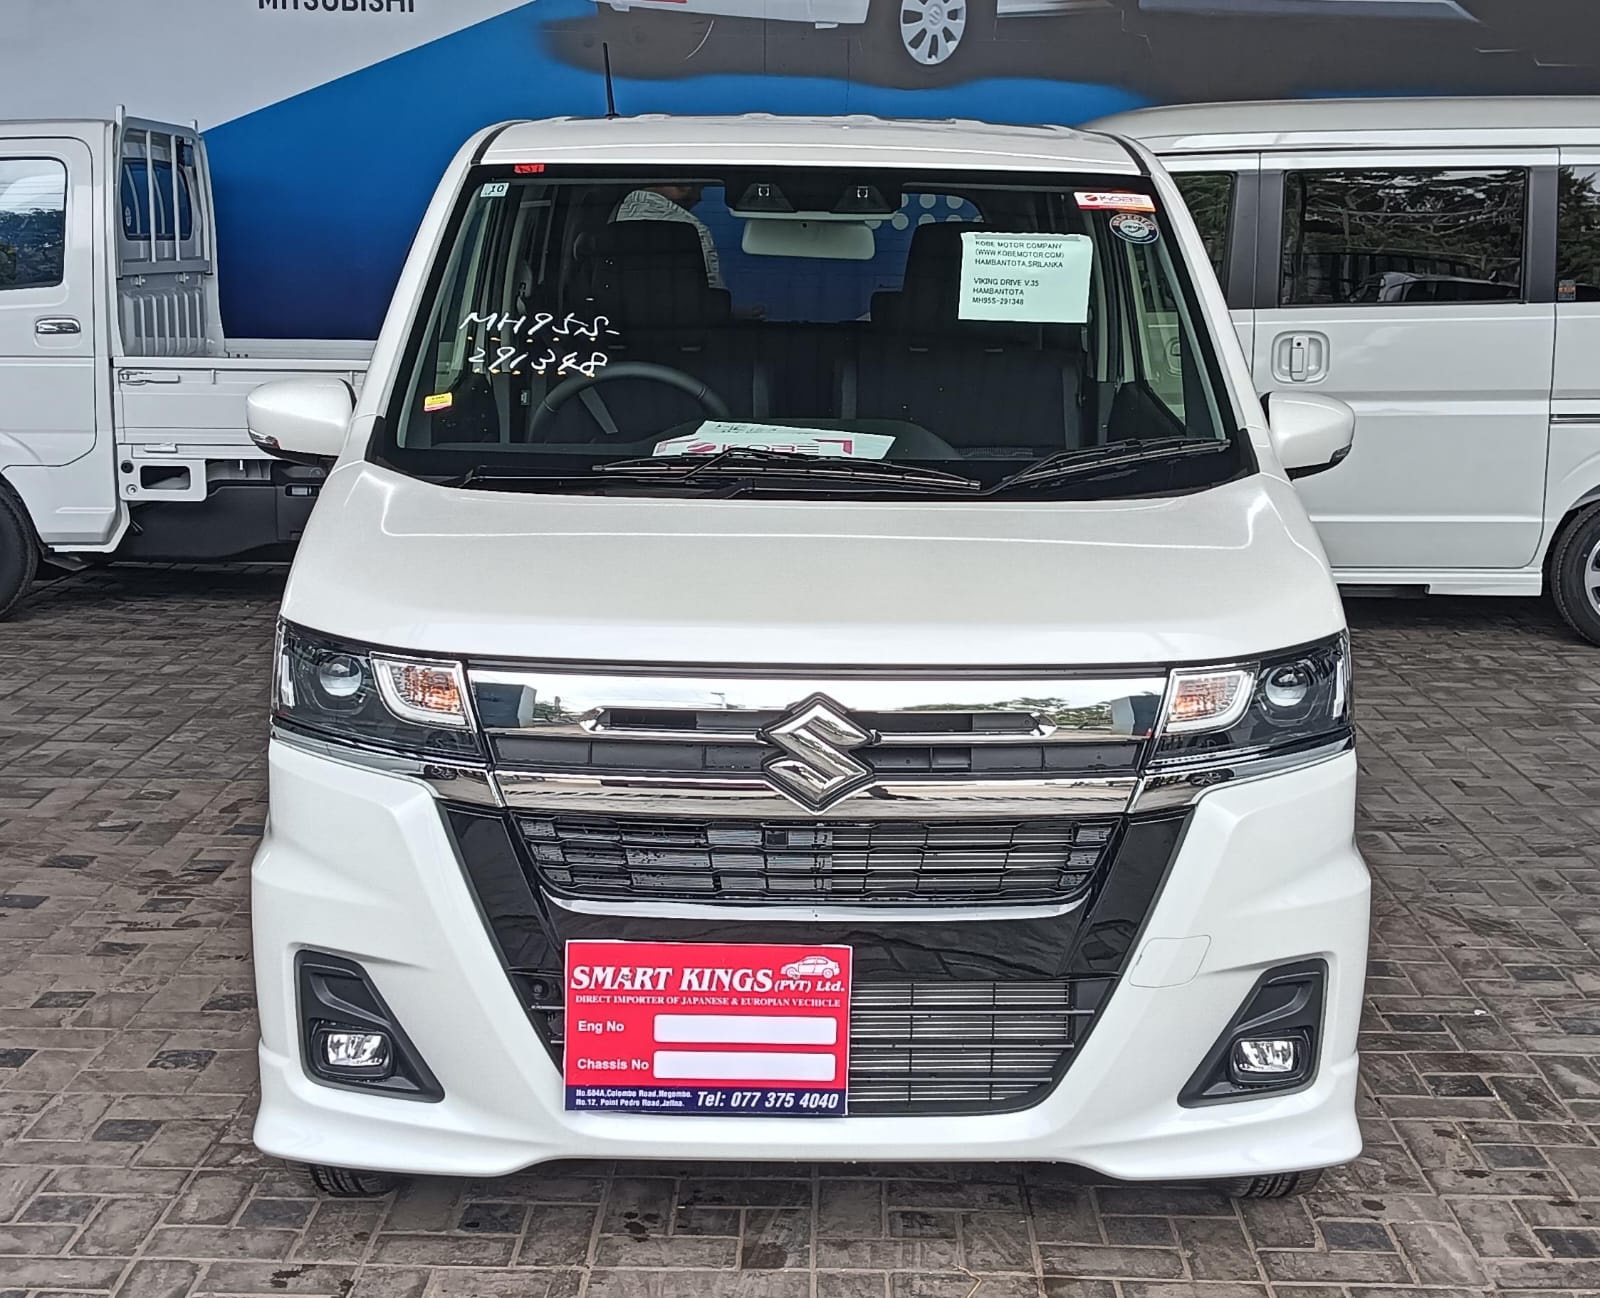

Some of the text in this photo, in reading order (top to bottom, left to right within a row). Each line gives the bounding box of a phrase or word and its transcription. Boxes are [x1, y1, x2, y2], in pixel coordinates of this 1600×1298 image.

[997, 241, 1025, 249] MOTOR
[973, 277, 1040, 287] VIKING DRIVE V.35
[972, 287, 1025, 296] HAMBANTOTA
[972, 297, 1025, 305] MH95S-291348
[570, 966, 846, 993] SMART KINGS (PVT) Ltd.
[575, 995, 841, 1007] DIRECT IMPORTER OF JAPANESE & EUROPIAN VECHICLE
[578, 1020, 625, 1035] Eng No
[577, 1058, 649, 1070] Chassis No
[697, 1091, 839, 1108] Tel: 077 375 4040
